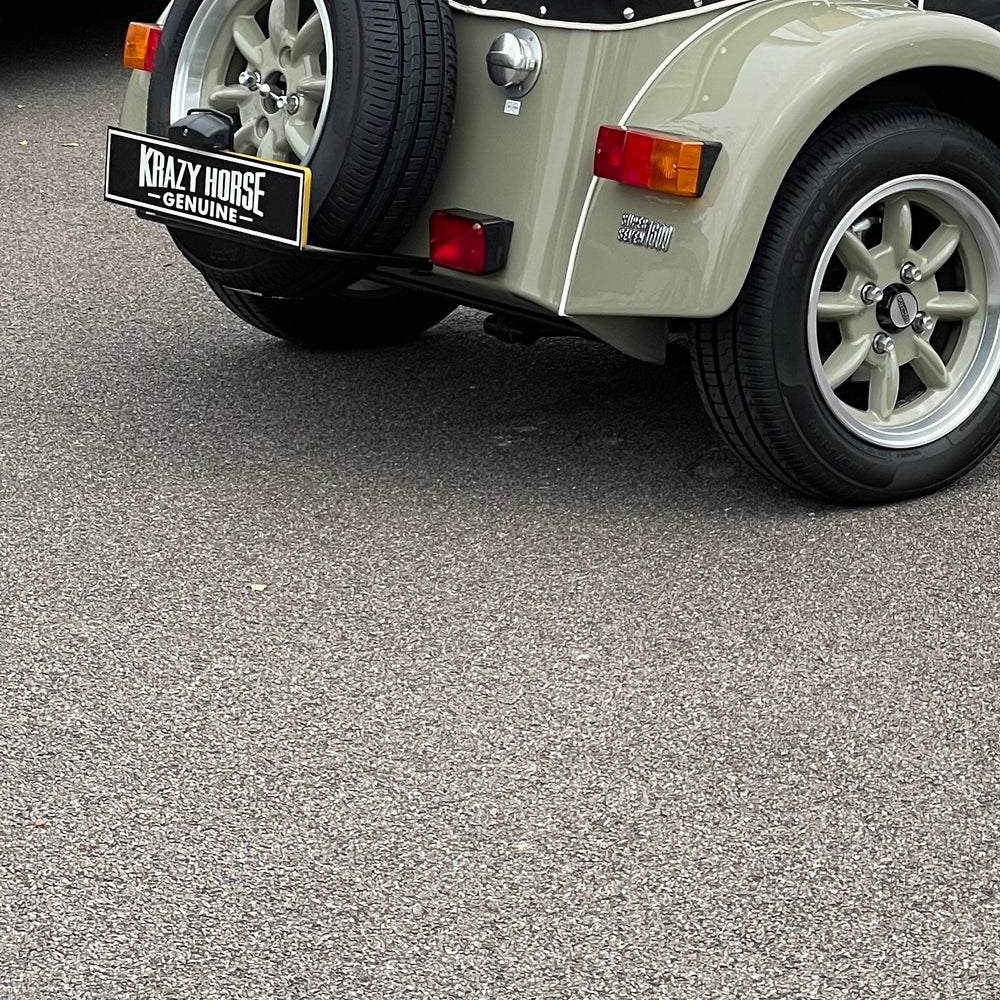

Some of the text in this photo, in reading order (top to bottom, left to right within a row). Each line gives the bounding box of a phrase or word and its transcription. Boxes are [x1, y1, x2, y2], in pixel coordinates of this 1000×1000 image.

[138, 143, 266, 218] KRAZY HORSE
[162, 192, 238, 223] GENUINE
